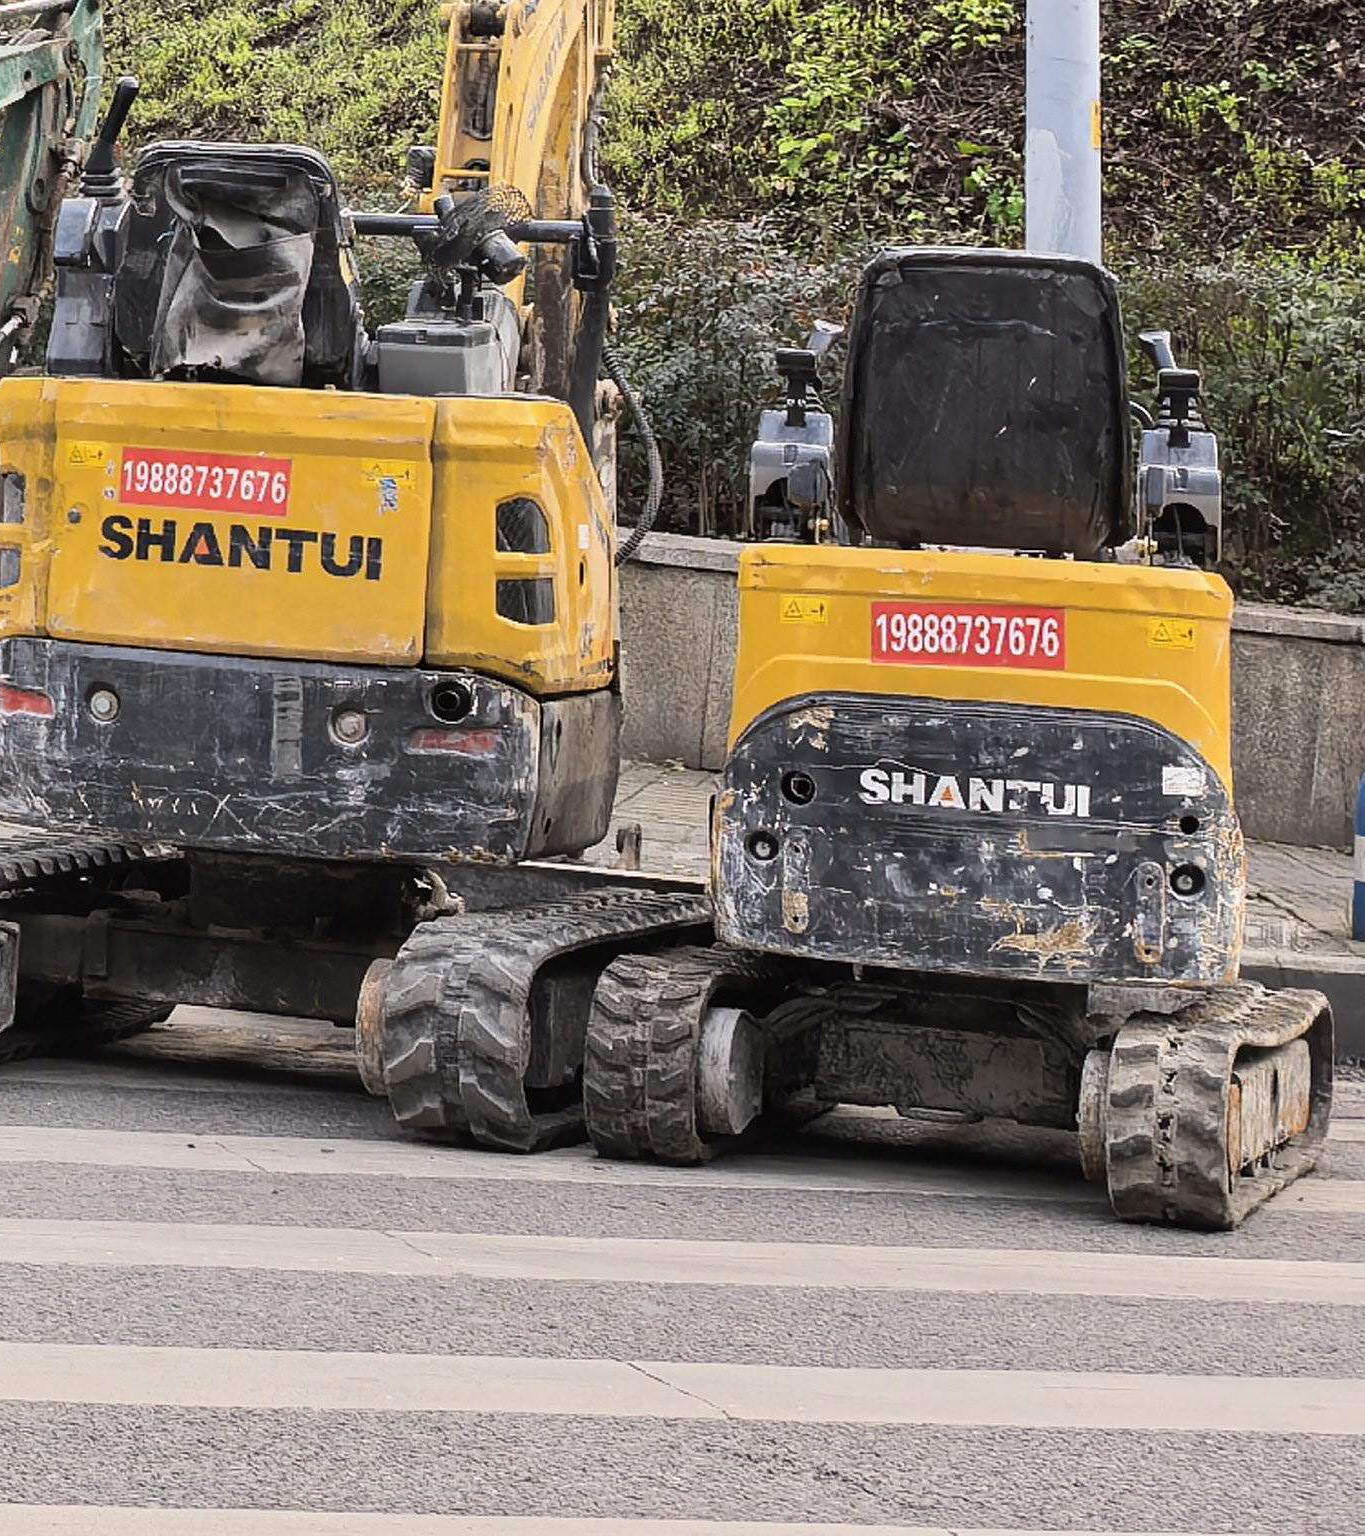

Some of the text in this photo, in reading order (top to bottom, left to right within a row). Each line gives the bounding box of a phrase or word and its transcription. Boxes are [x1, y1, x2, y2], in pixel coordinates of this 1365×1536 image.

[123, 460, 287, 504] 19888737676
[98, 514, 383, 581] SHANTUI
[875, 613, 1060, 657] 19888737676
[857, 767, 1091, 818] SHANTUI
